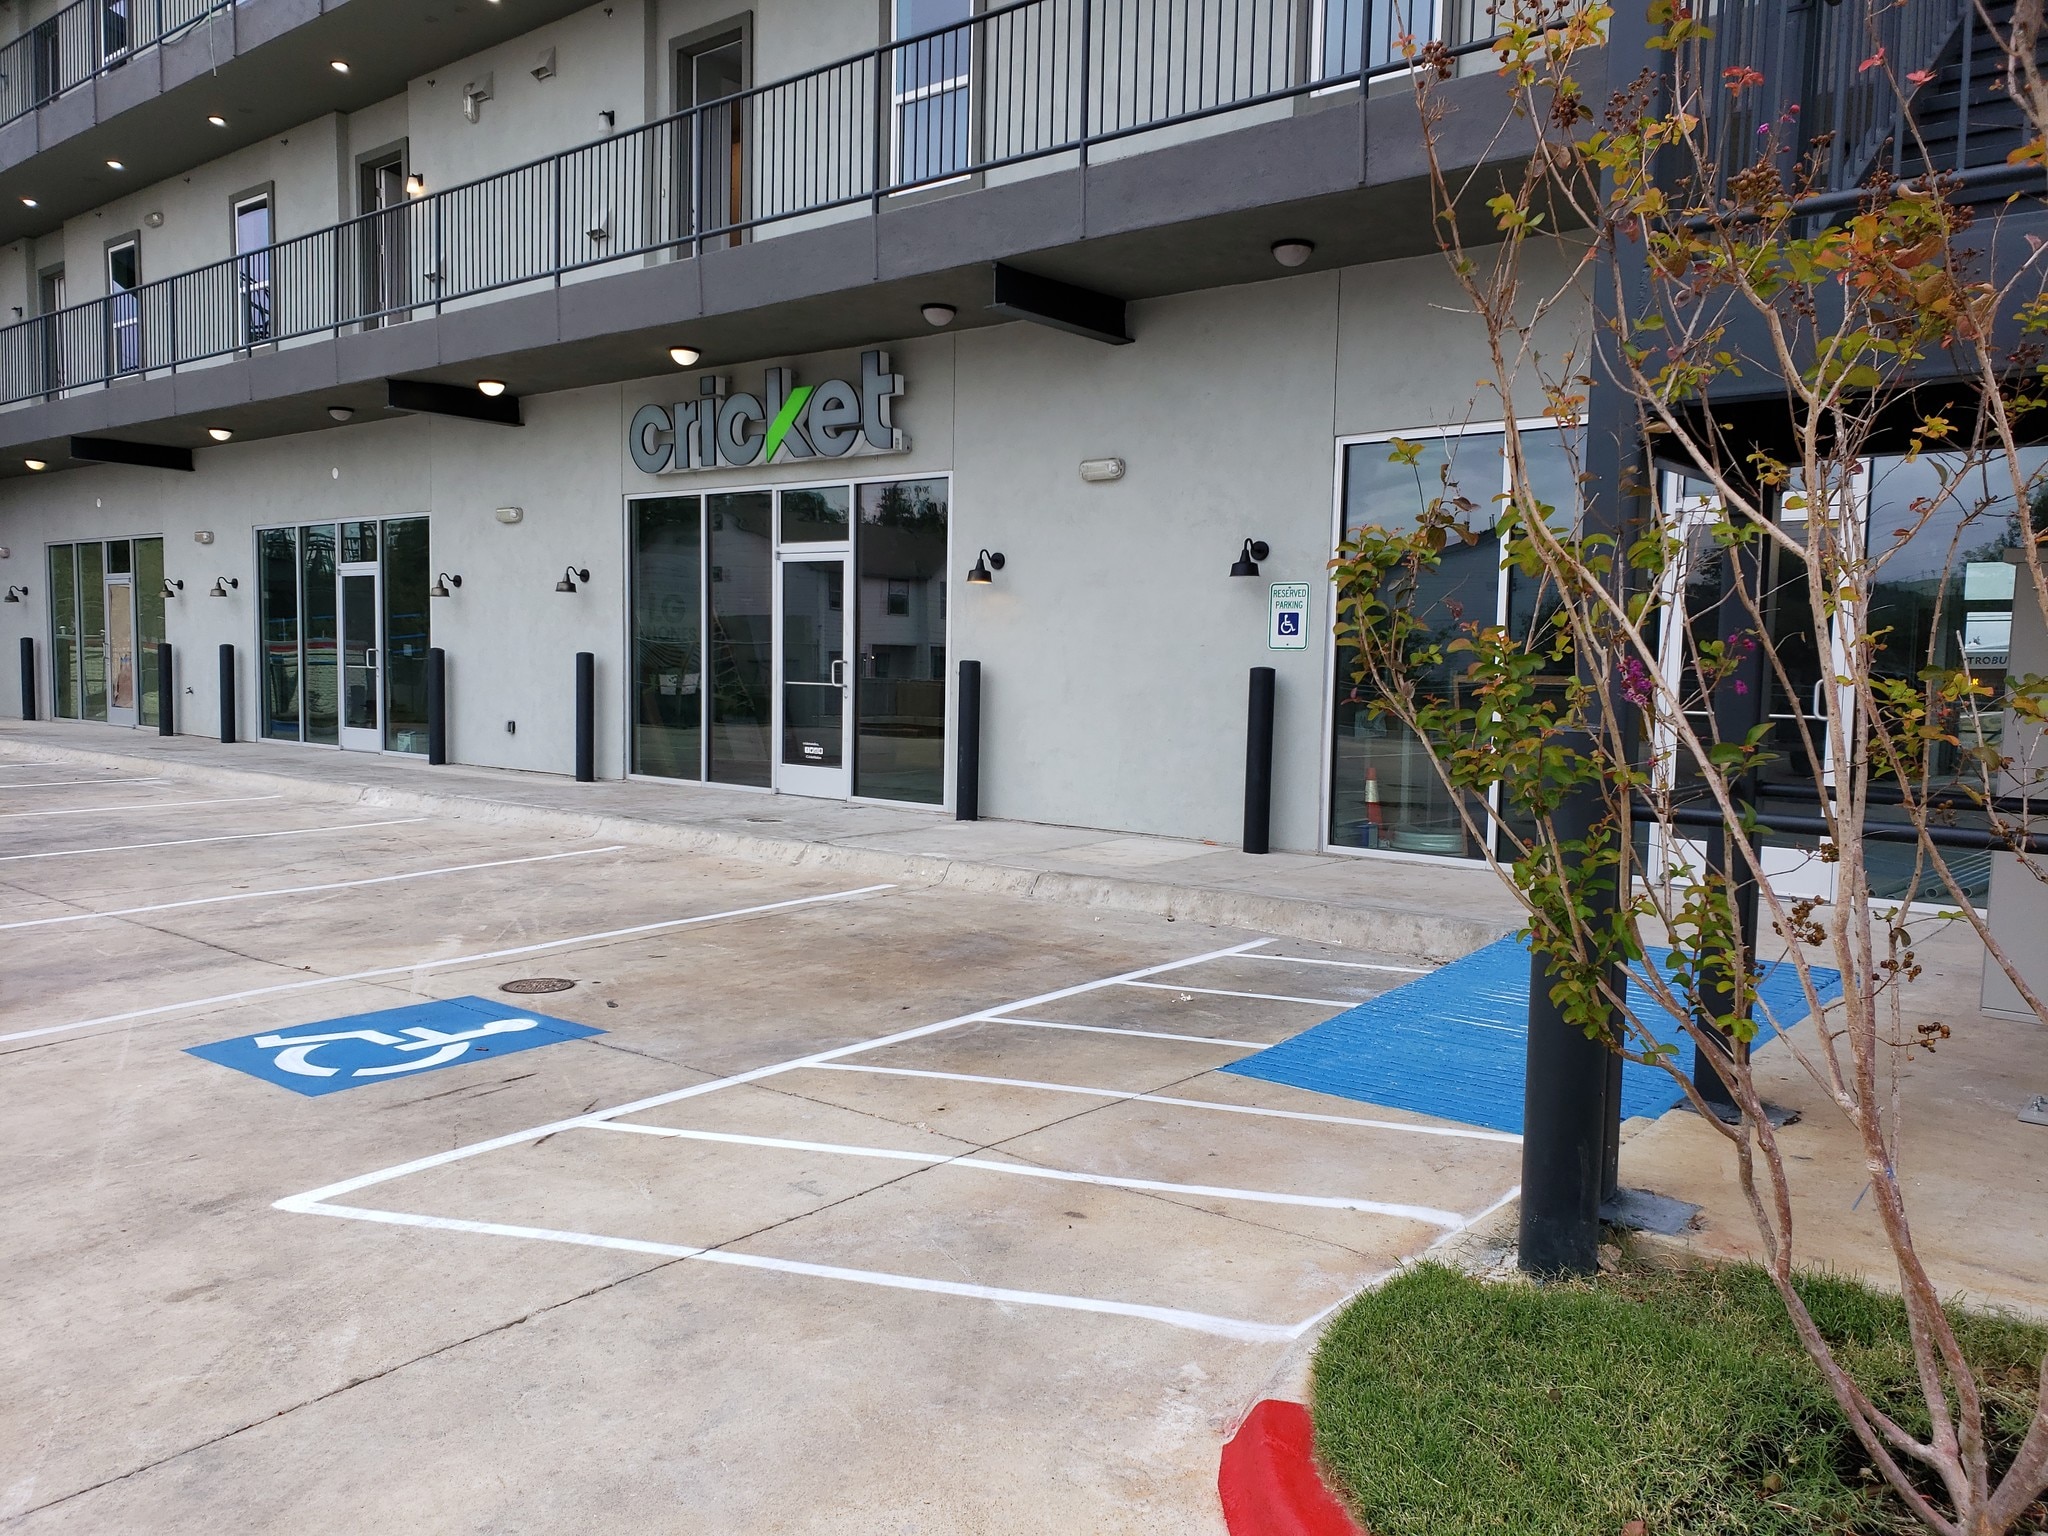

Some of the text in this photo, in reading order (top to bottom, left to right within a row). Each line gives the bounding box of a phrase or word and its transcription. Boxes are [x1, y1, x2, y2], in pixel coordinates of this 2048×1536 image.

[629, 350, 900, 475] cricket
[1273, 589, 1307, 598] RESERVED
[1275, 600, 1304, 609] PARKING
[1966, 656, 2008, 665] TROBU
